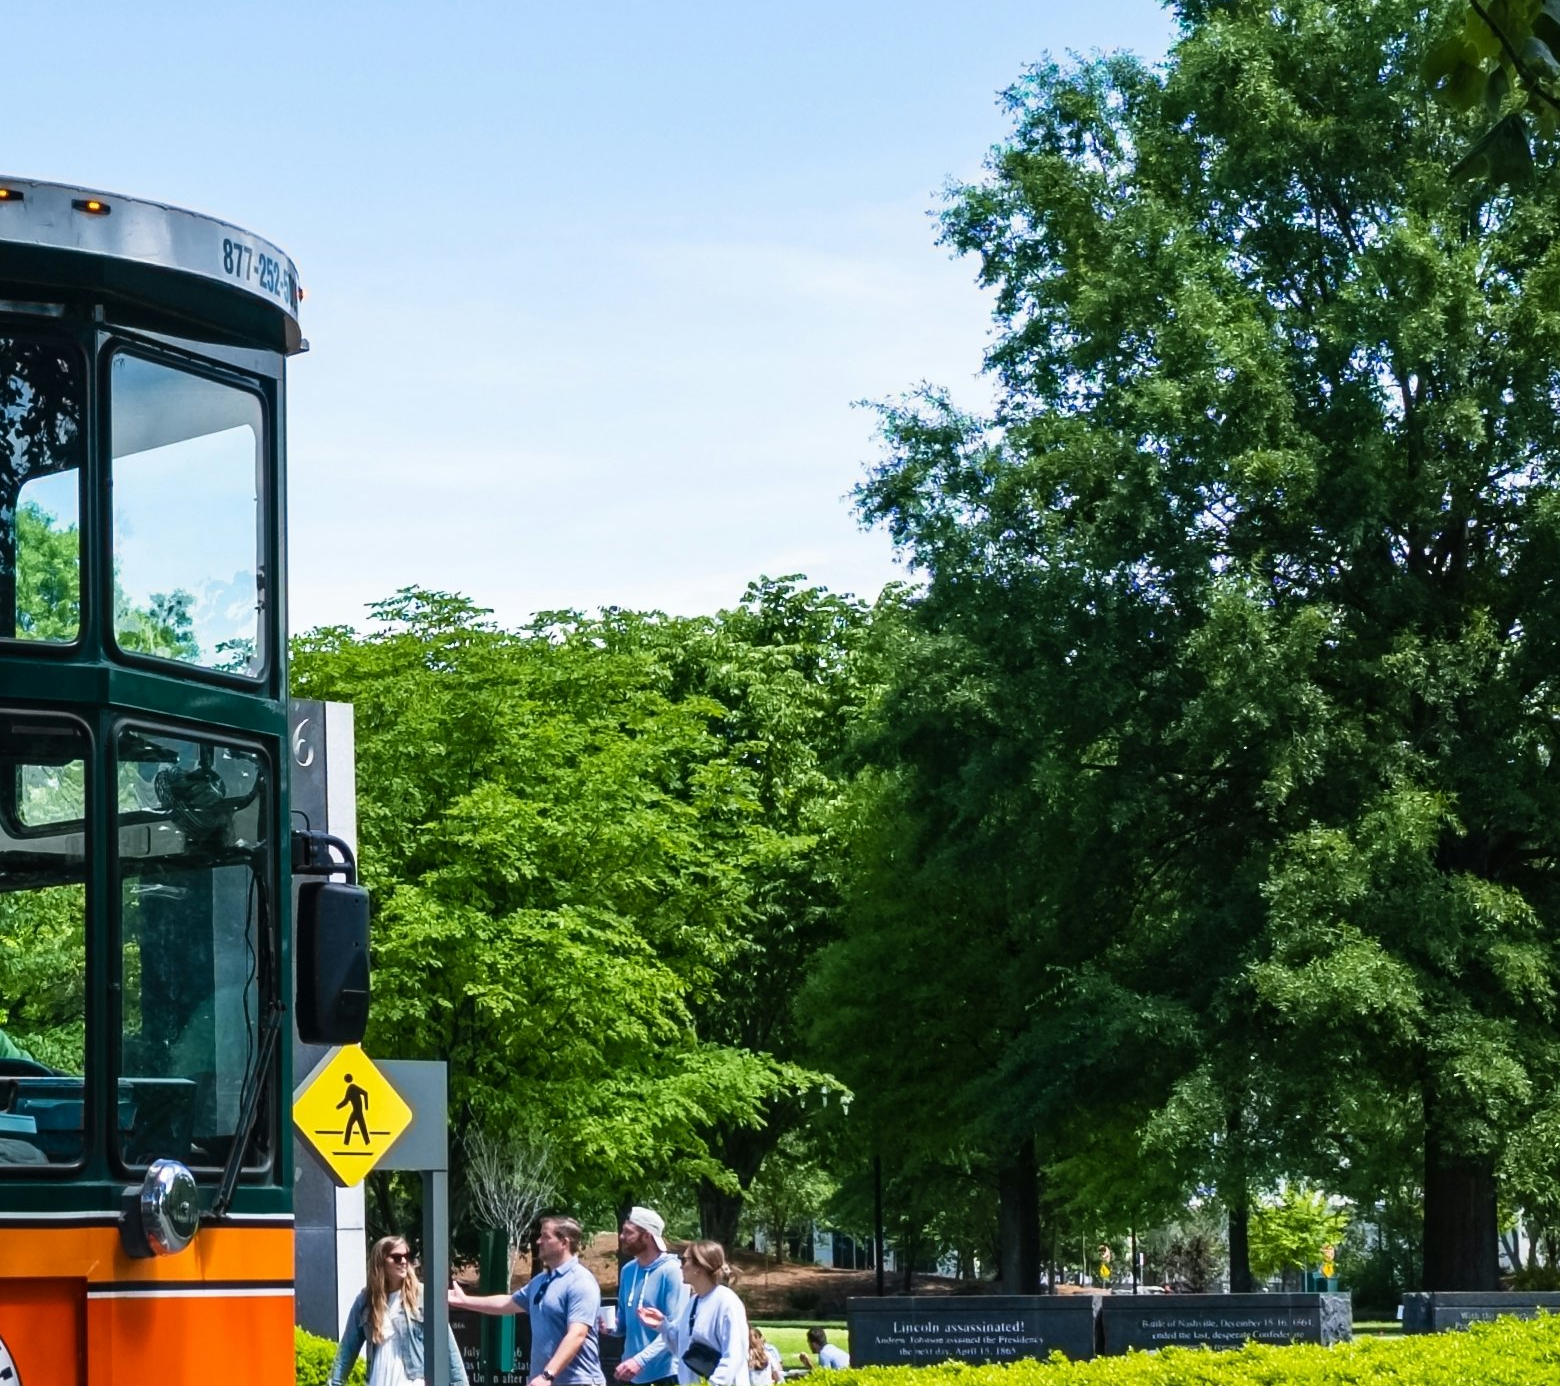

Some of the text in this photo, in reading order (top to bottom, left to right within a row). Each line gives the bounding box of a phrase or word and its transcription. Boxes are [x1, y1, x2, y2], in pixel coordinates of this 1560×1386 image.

[894, 1321, 1025, 1334] Lincoln assassinated!
[983, 1336, 996, 1345] the
[464, 1347, 480, 1358] July
[899, 1347, 912, 1356] the
[955, 1347, 977, 1357] April
[502, 1372, 523, 1383] after
